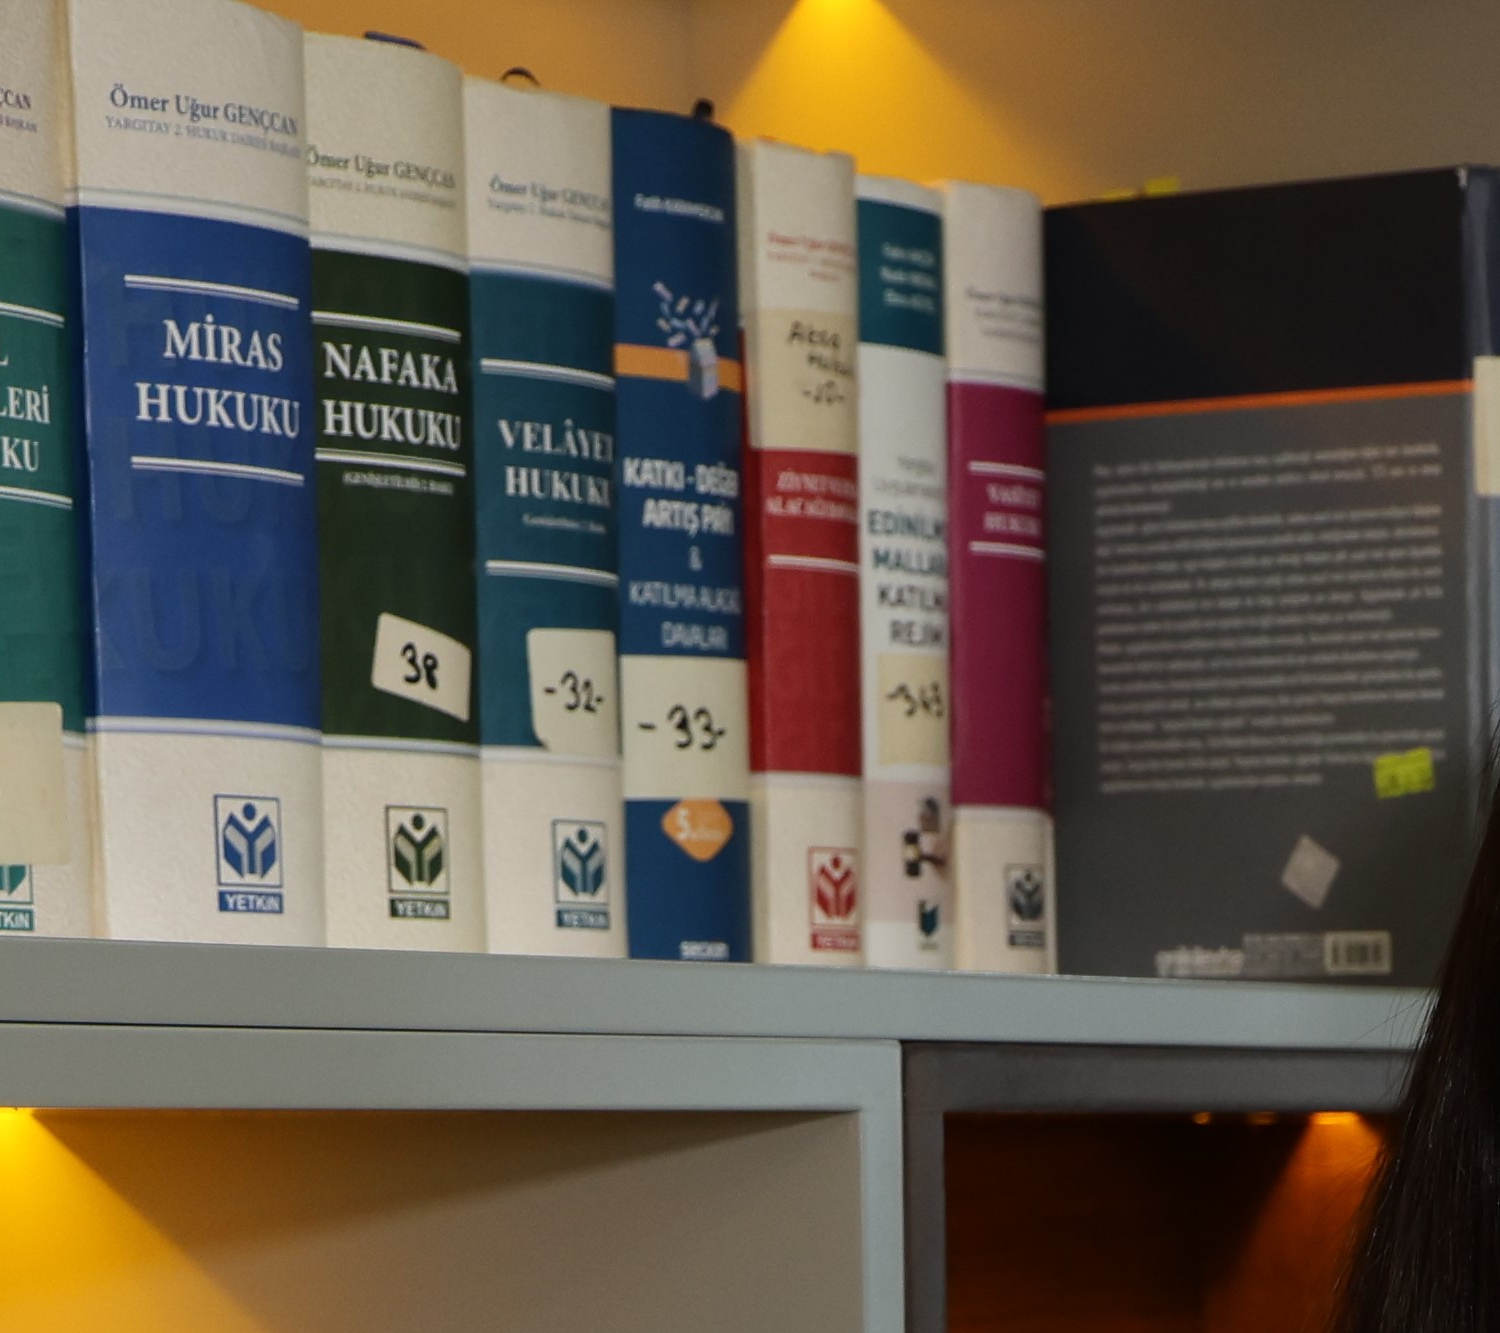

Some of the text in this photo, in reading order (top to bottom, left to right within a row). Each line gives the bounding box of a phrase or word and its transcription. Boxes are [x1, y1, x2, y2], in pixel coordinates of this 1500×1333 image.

[110, 83, 299, 137] Ömer Uğur GENÇCAN
[162, 313, 284, 373] MİRAS
[322, 341, 460, 395] NAFAKA
[135, 381, 300, 439] HUKUKU
[322, 398, 461, 451] HUKUKU
